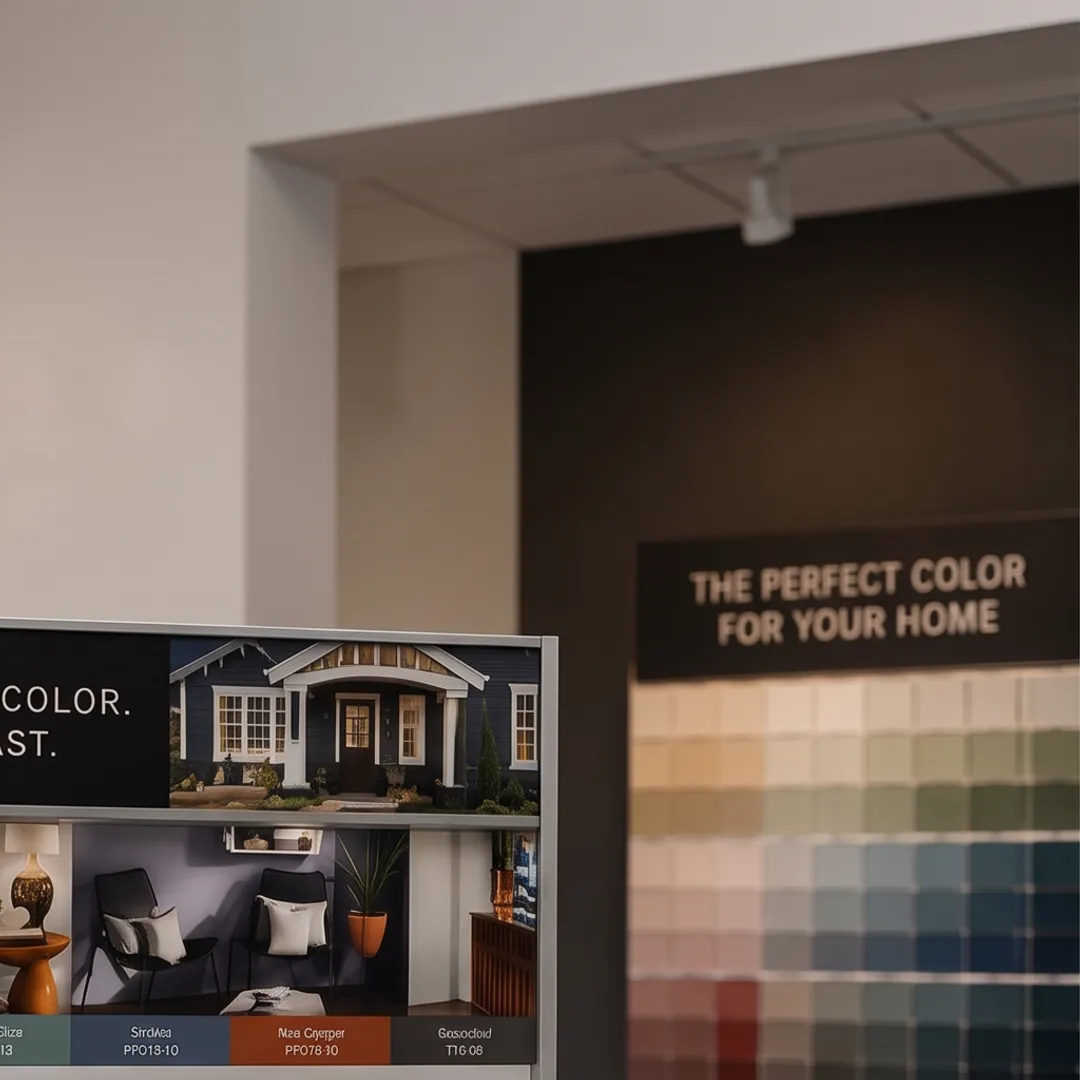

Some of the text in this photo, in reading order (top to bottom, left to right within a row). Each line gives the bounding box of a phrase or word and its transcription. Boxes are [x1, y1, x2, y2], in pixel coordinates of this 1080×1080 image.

[691, 554, 1026, 604] THE PERFECT COLOR
[719, 600, 999, 645] FOR YOUR HOME
[1, 684, 130, 716] COLOR.
